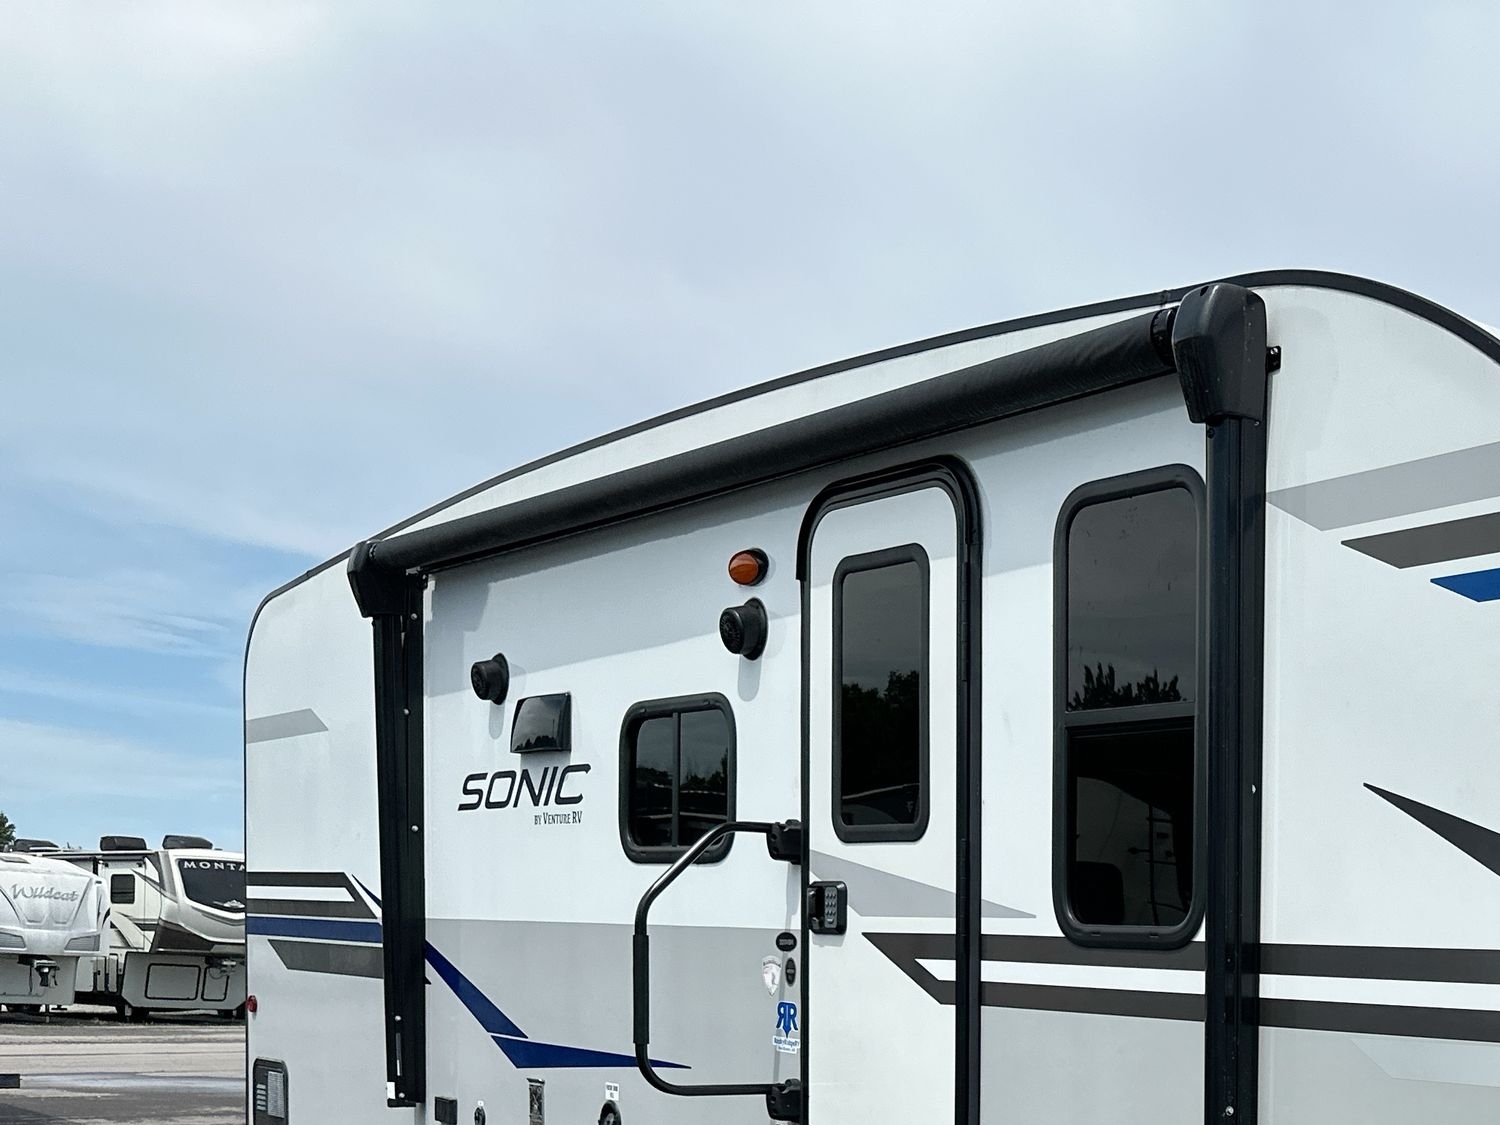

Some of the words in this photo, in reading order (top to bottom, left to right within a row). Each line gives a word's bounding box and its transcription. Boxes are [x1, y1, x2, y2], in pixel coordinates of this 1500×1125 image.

[458, 763, 592, 811] SONIC
[572, 810, 583, 824] RV
[11, 883, 80, 902] Wildcat
